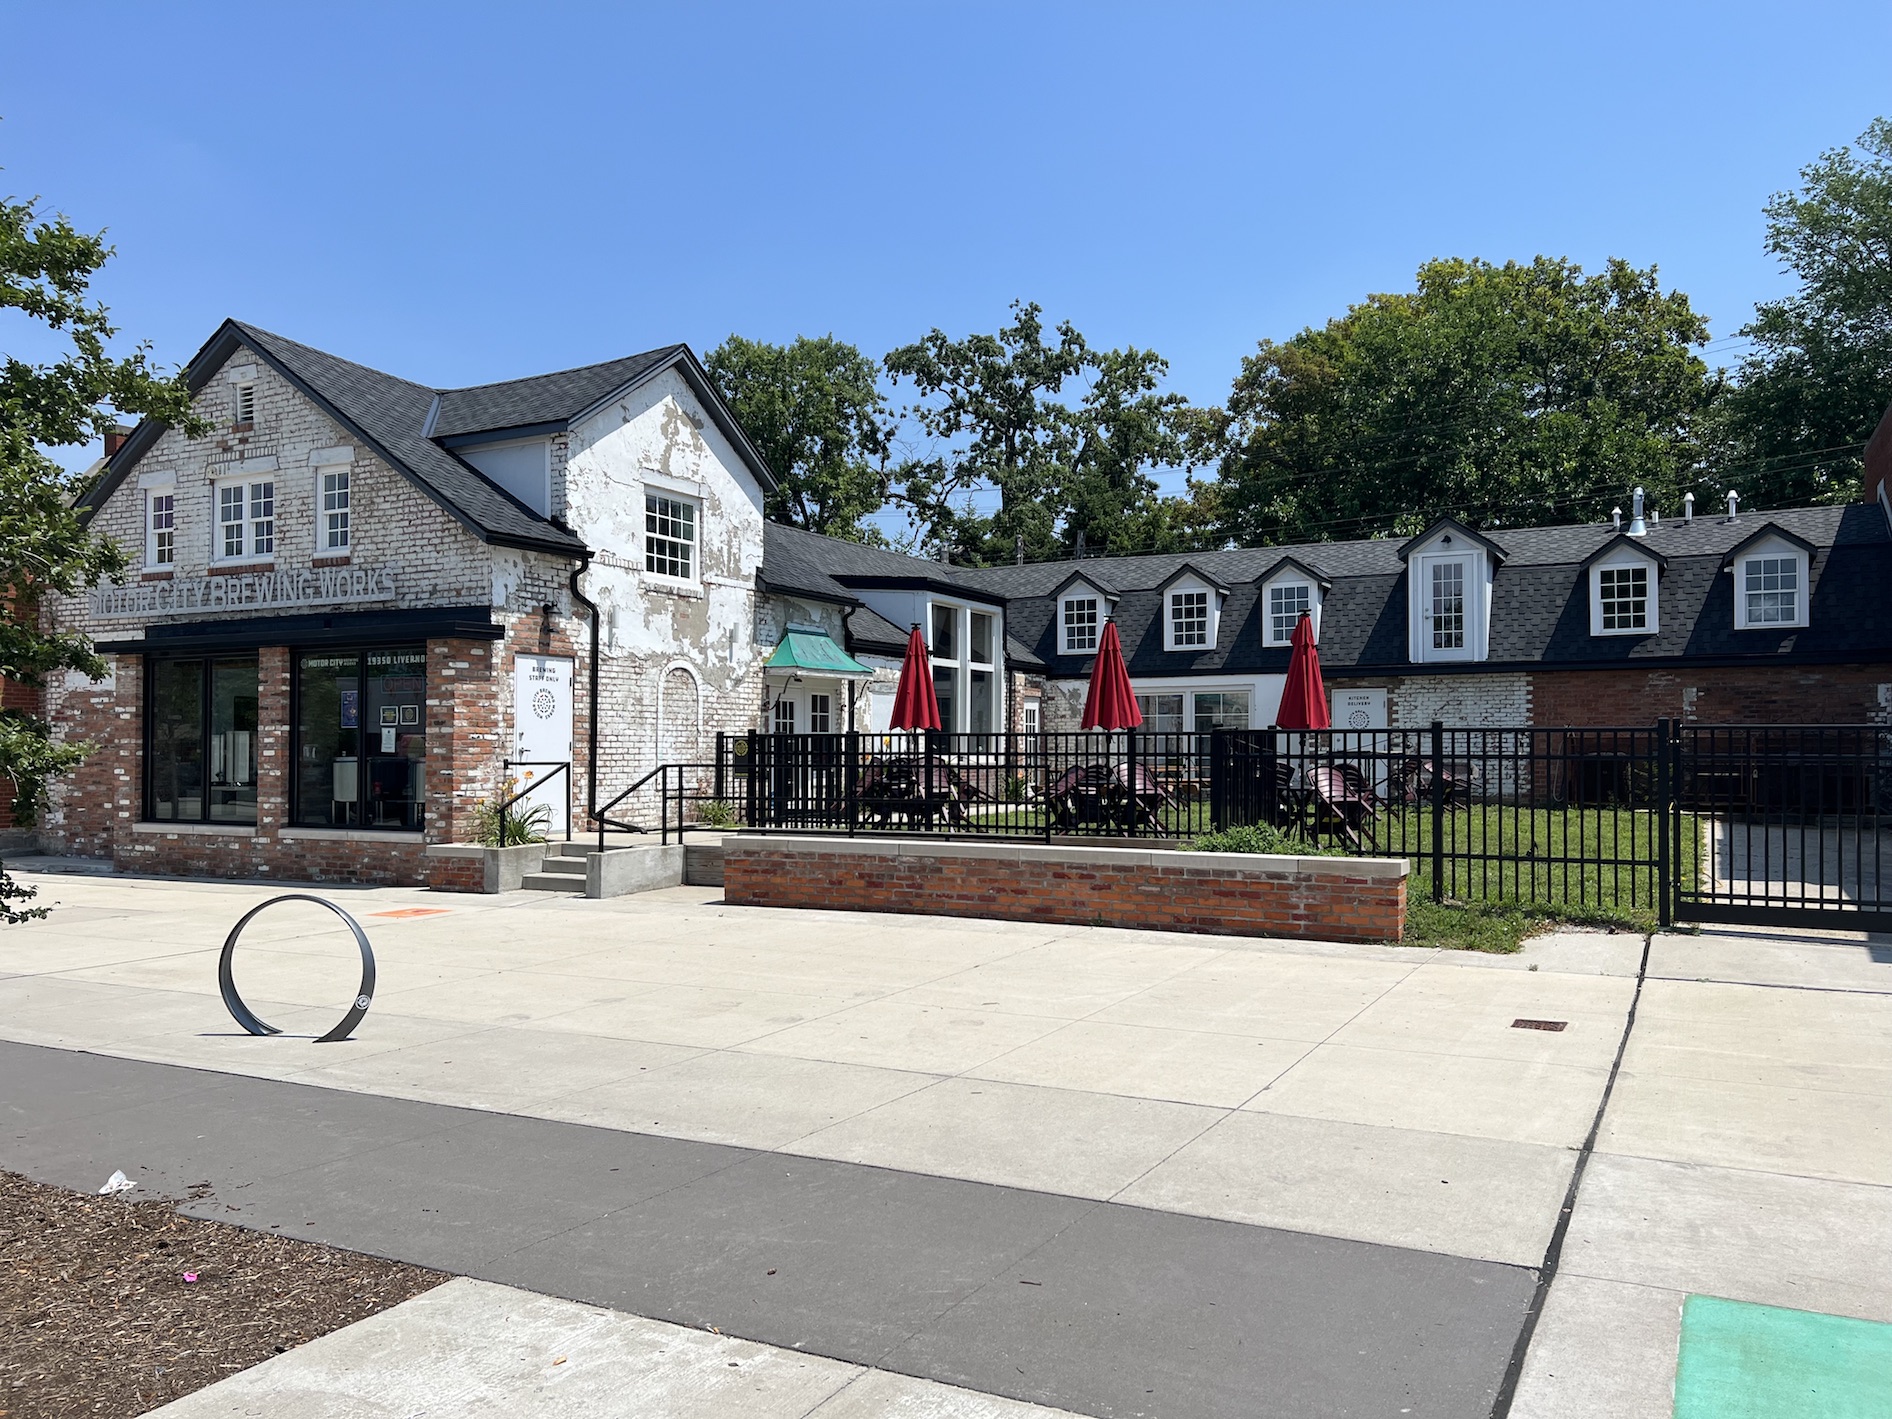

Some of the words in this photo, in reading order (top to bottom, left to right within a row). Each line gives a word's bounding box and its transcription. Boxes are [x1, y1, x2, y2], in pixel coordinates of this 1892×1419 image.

[89, 587, 151, 616] MOTOR
[155, 580, 207, 614] CITY
[210, 570, 314, 612] BREWING
[319, 567, 396, 603] WORKS
[308, 658, 329, 668] MOTOR
[329, 658, 344, 667] CITY
[367, 656, 391, 666] 19350
[384, 677, 422, 691] OPEN
